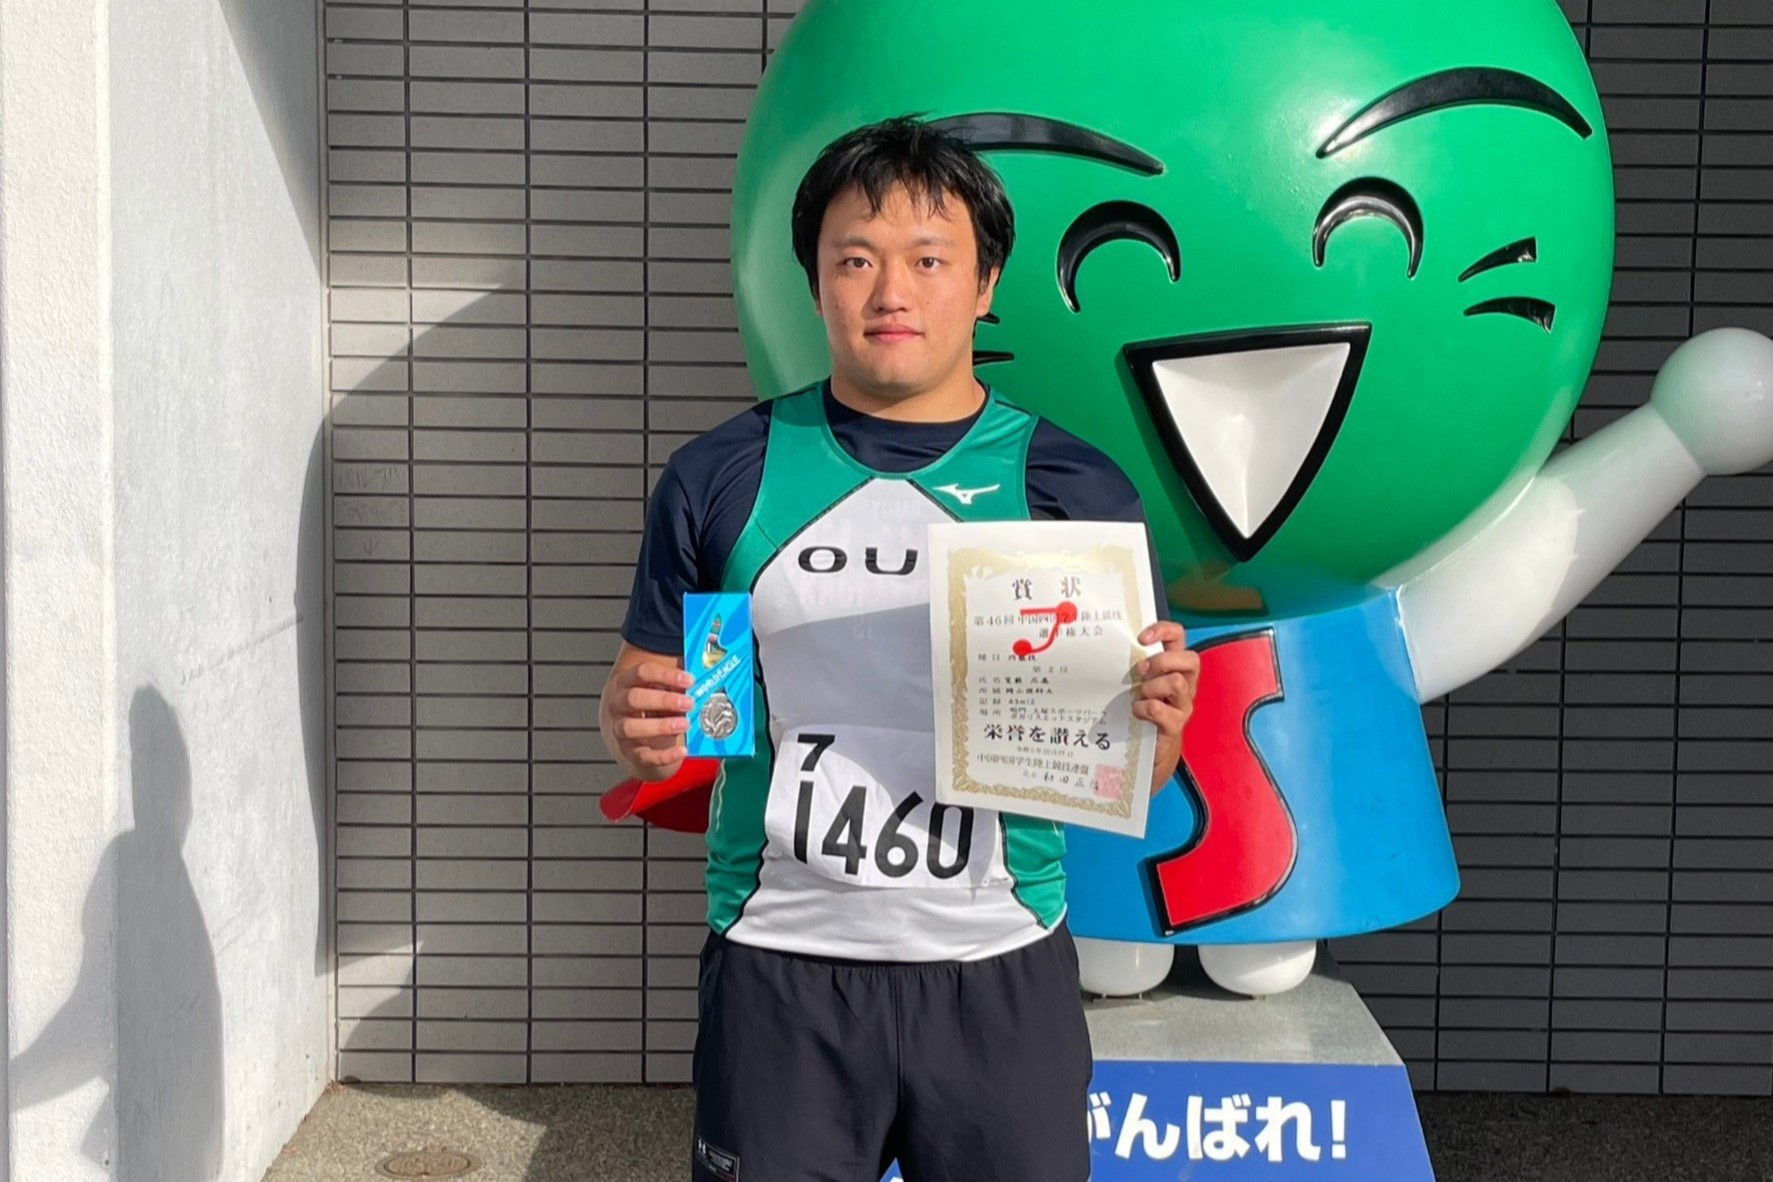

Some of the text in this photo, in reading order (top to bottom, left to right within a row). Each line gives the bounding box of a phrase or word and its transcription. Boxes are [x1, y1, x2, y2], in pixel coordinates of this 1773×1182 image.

[1012, 576, 1082, 600] 賞状
[797, 734, 836, 772] 7
[984, 724, 1110, 750] 栄誉を讃える
[793, 780, 974, 880] 1460
